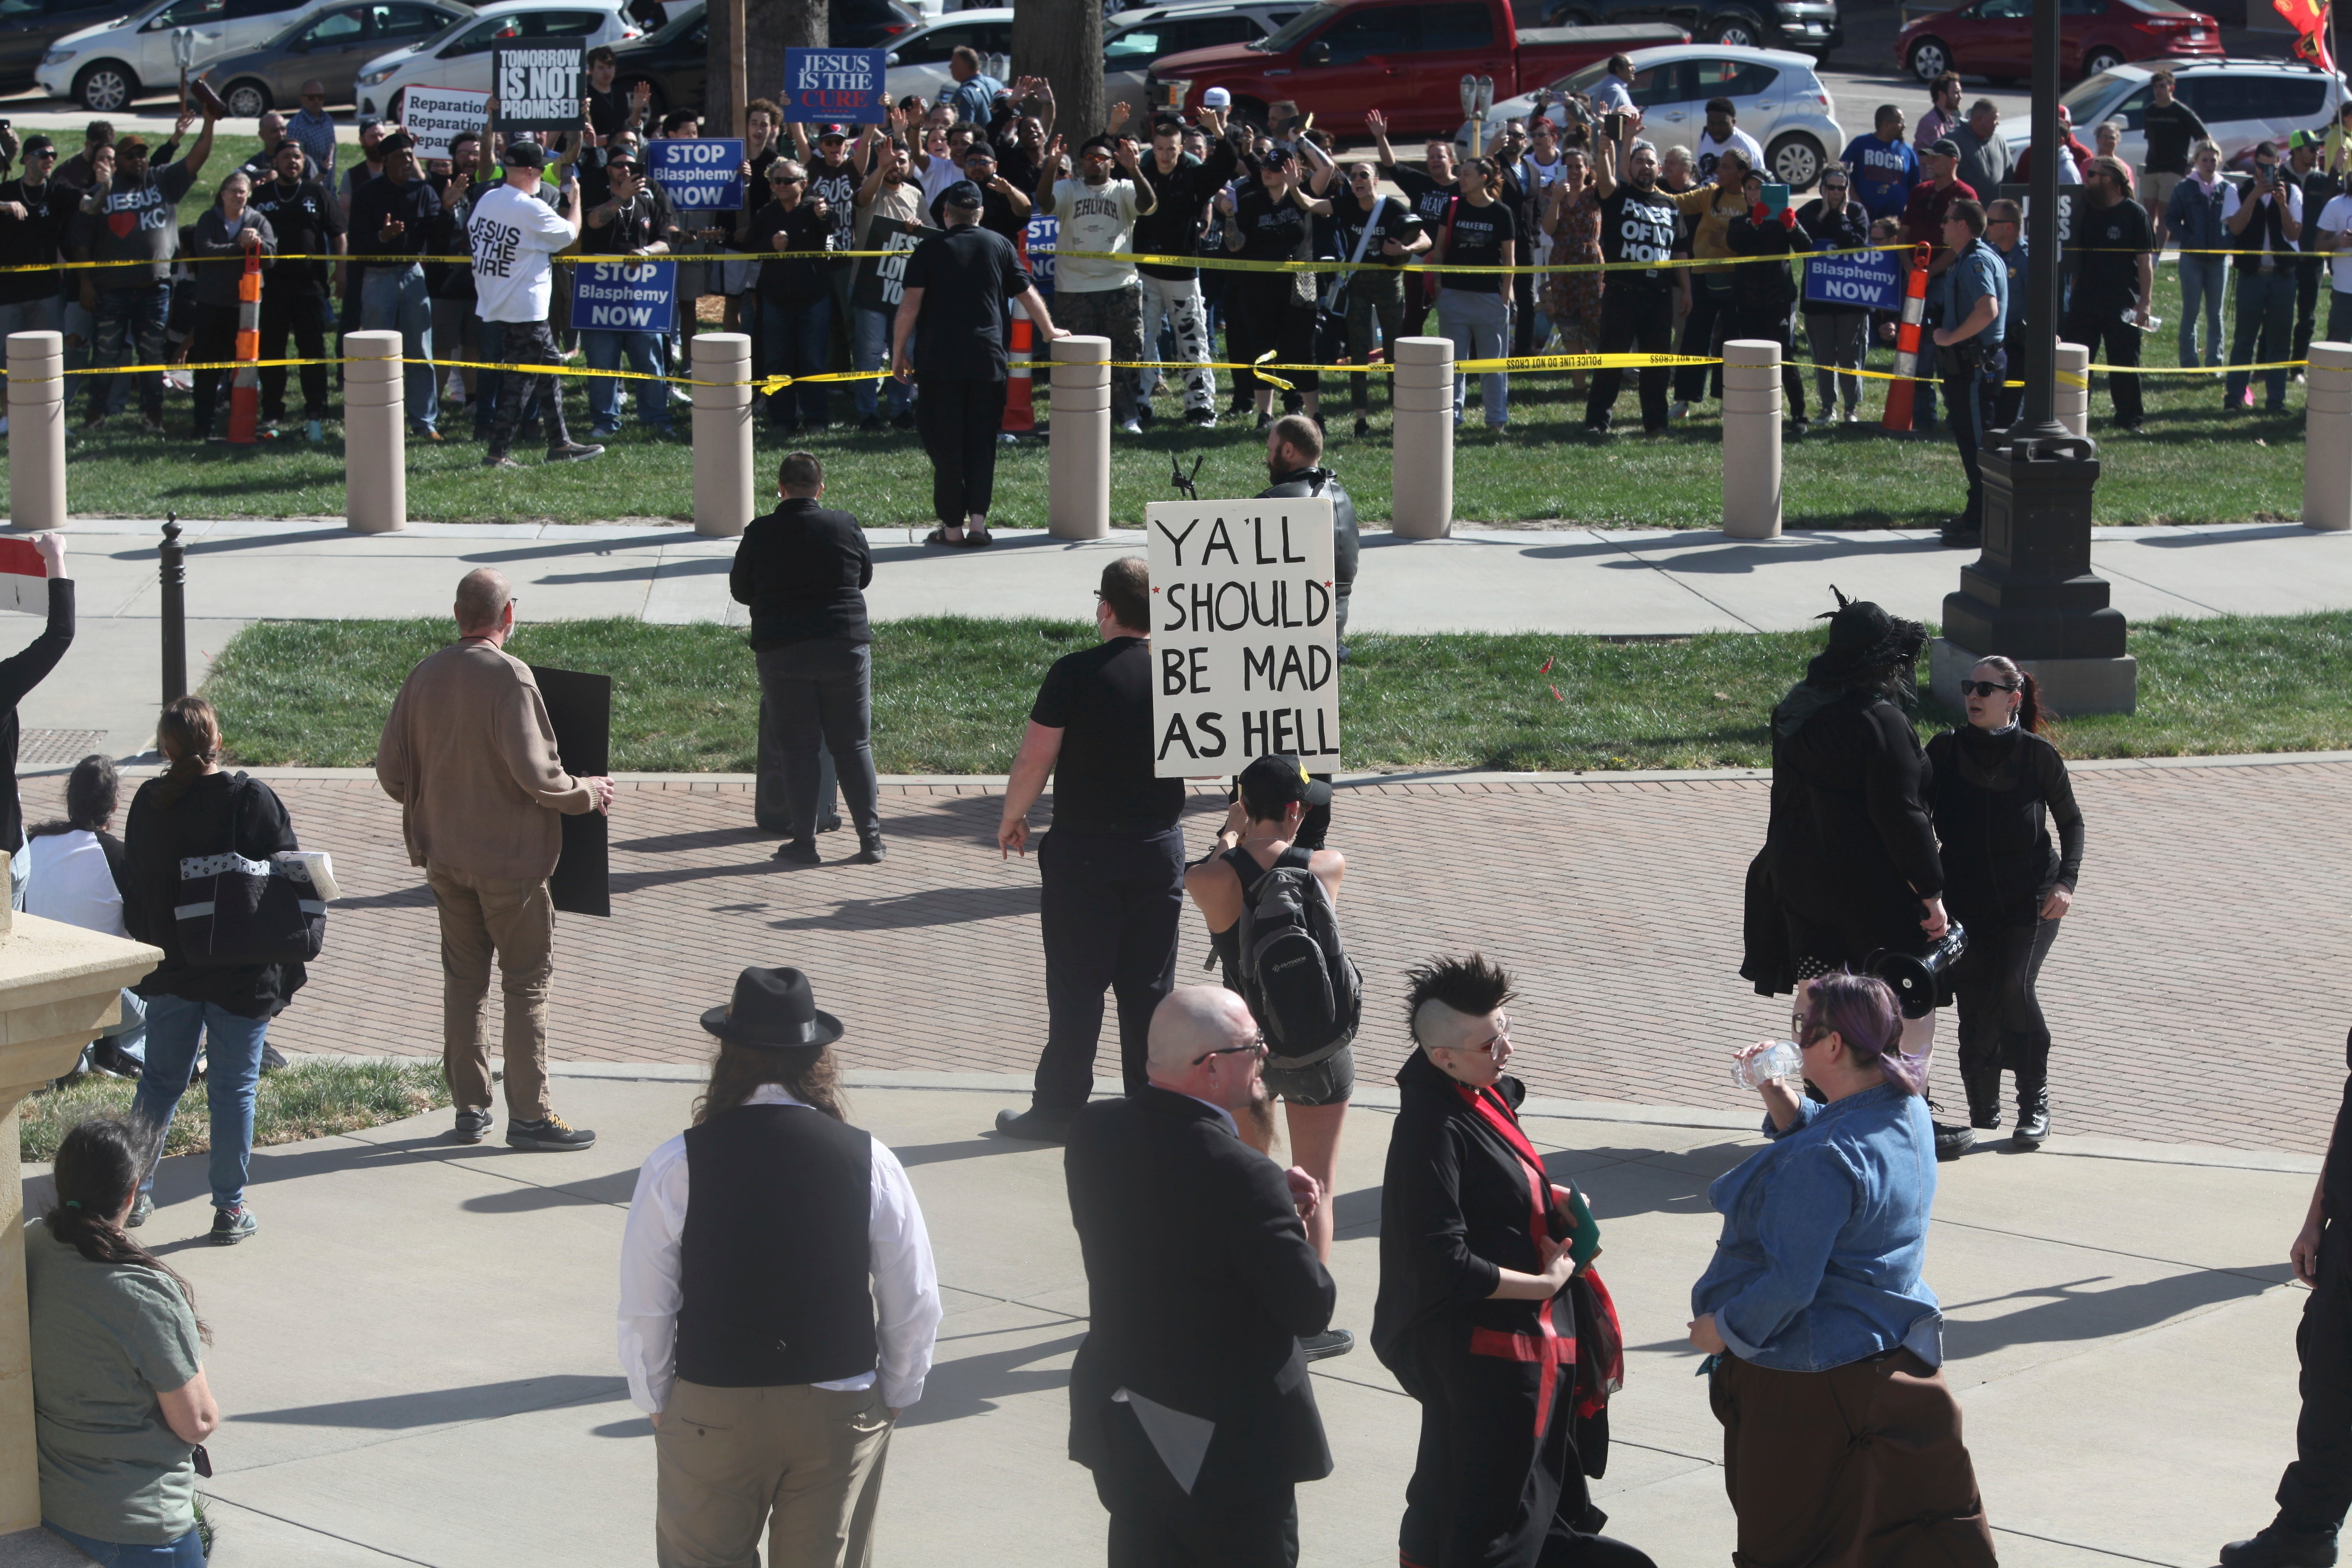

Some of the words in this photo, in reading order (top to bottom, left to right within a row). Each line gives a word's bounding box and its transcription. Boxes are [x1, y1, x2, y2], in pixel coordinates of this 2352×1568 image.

[500, 49, 580, 68] TOMORROW
[800, 55, 870, 74] JESUS
[500, 67, 525, 100] IS
[529, 67, 580, 100] NOT
[797, 72, 819, 90] IS
[823, 73, 873, 90] THE
[501, 98, 579, 119] PROMISED
[801, 90, 868, 108] CURE
[666, 144, 725, 163] STOP
[1865, 149, 1904, 172] ROCK
[653, 167, 738, 183] Blasphemy
[102, 185, 162, 215] JESUS
[668, 187, 724, 205] NOW
[140, 208, 166, 231] KC
[1027, 219, 1060, 238] ST
[470, 217, 521, 246] JESUS
[1621, 220, 1652, 242] OF
[482, 238, 516, 262] THE
[882, 231, 925, 258] JES
[594, 263, 657, 283] STOP
[1032, 258, 1056, 277] NO
[1812, 262, 1896, 286] Blasphemy
[579, 284, 669, 304] Blasphemy
[882, 278, 905, 305] YO
[1826, 280, 1882, 302] NOW
[592, 306, 652, 327] NOW
[1506, 359, 1529, 369] CROSS
[1532, 358, 1545, 369] NOT
[1548, 358, 1557, 368] DO
[1560, 357, 1575, 367] LINE
[1577, 356, 1602, 366] POLICE
[1154, 516, 1305, 566] YA'LL
[1163, 579, 1330, 632] SHOULD
[1162, 647, 1212, 696] BE
[1243, 645, 1332, 692] MAD
[1157, 712, 1227, 761] AS
[1242, 707, 1340, 757] HELL
